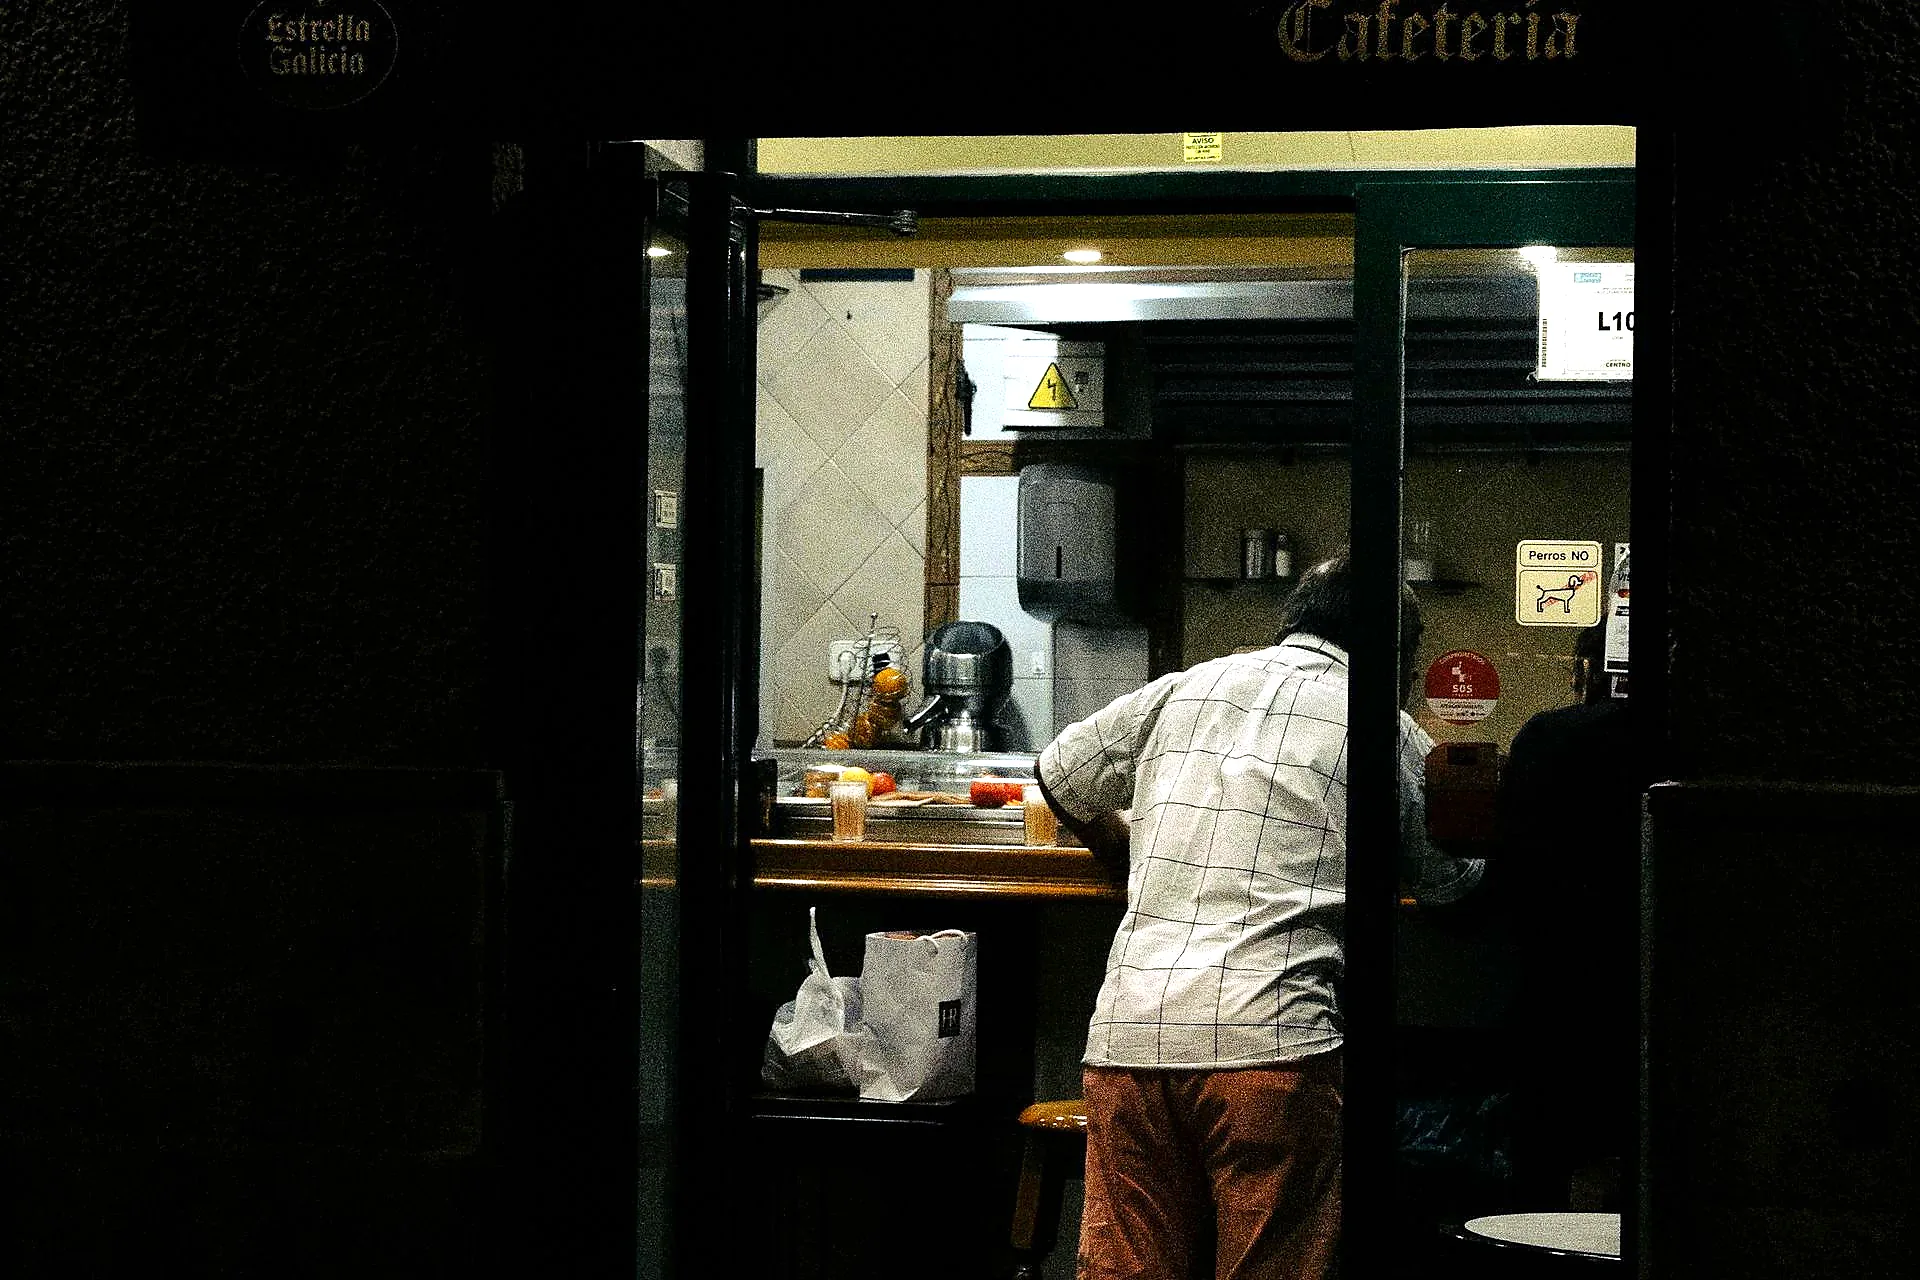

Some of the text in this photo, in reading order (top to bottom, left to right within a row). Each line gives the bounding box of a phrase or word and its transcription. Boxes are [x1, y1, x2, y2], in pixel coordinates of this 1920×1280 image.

[266, 13, 370, 42] Estrella
[269, 44, 366, 75] Galicia
[1528, 550, 1589, 561] Perros NO
[1452, 684, 1473, 693] SOS
